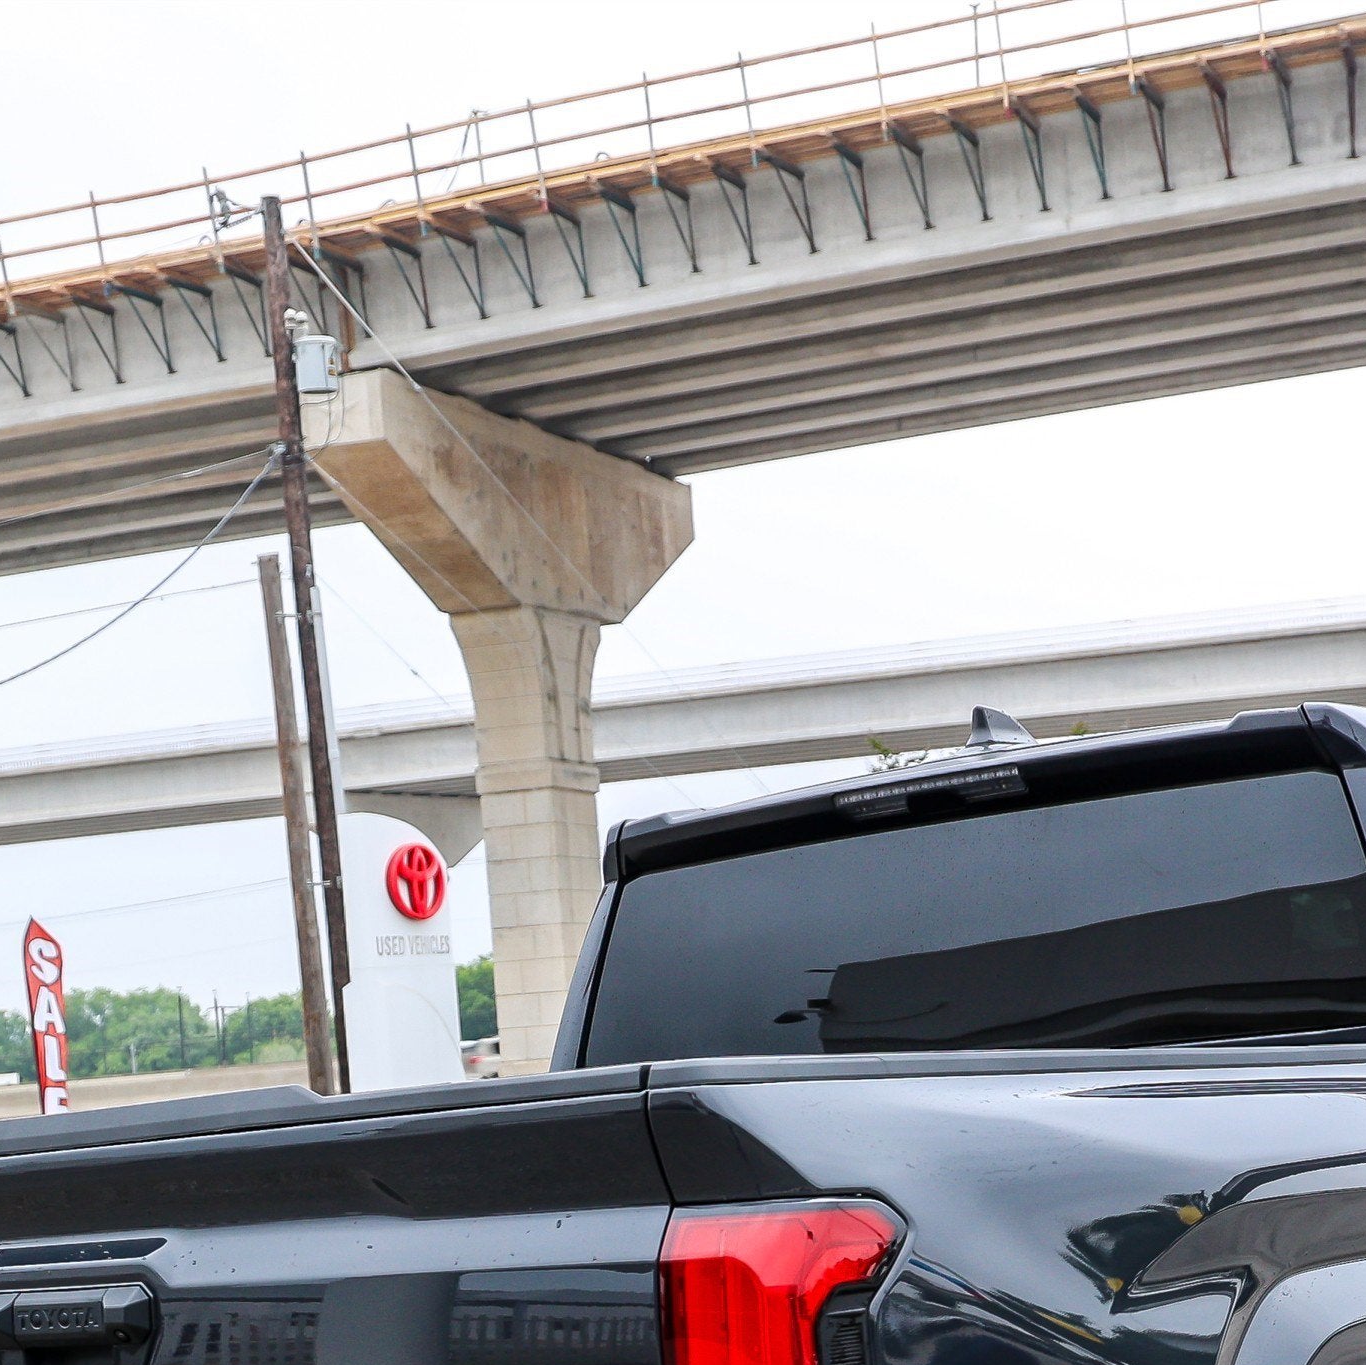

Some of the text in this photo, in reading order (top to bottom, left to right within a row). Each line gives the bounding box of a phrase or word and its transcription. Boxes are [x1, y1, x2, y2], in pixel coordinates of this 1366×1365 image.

[375, 933, 451, 956] USED VEHICLES
[28, 937, 69, 1114] SALE
[16, 1307, 100, 1330] TOYOTA
